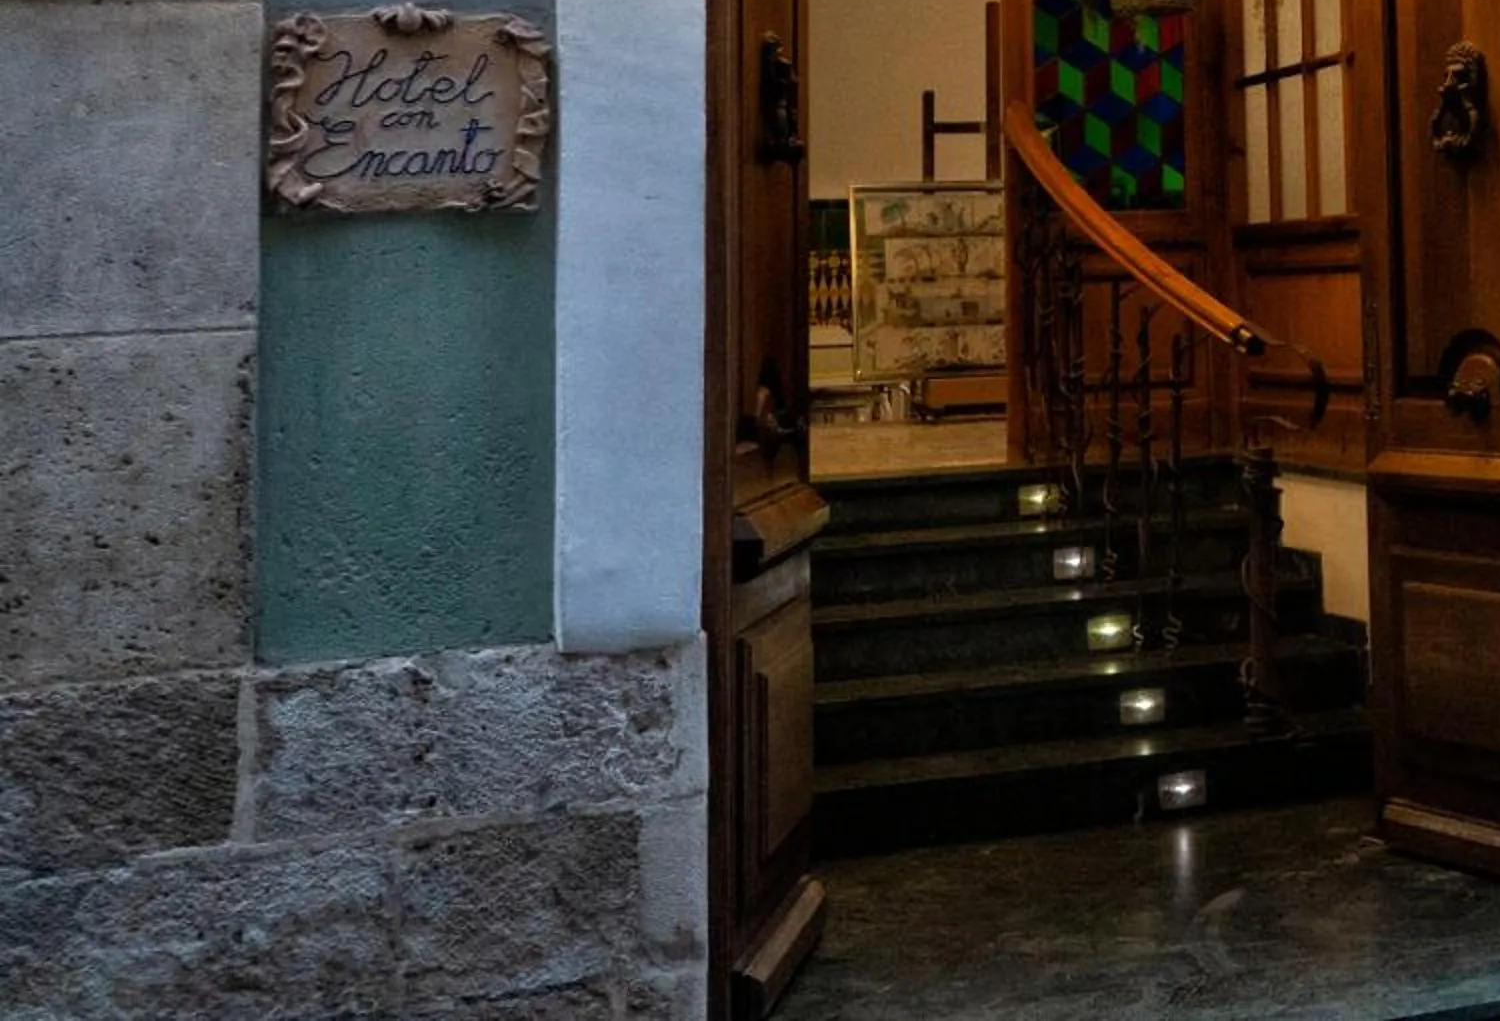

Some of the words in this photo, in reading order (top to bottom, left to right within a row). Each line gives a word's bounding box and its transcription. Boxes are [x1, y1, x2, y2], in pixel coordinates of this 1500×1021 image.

[316, 48, 494, 107] Hotel
[301, 111, 504, 180] Encanto
[379, 107, 440, 131] con
